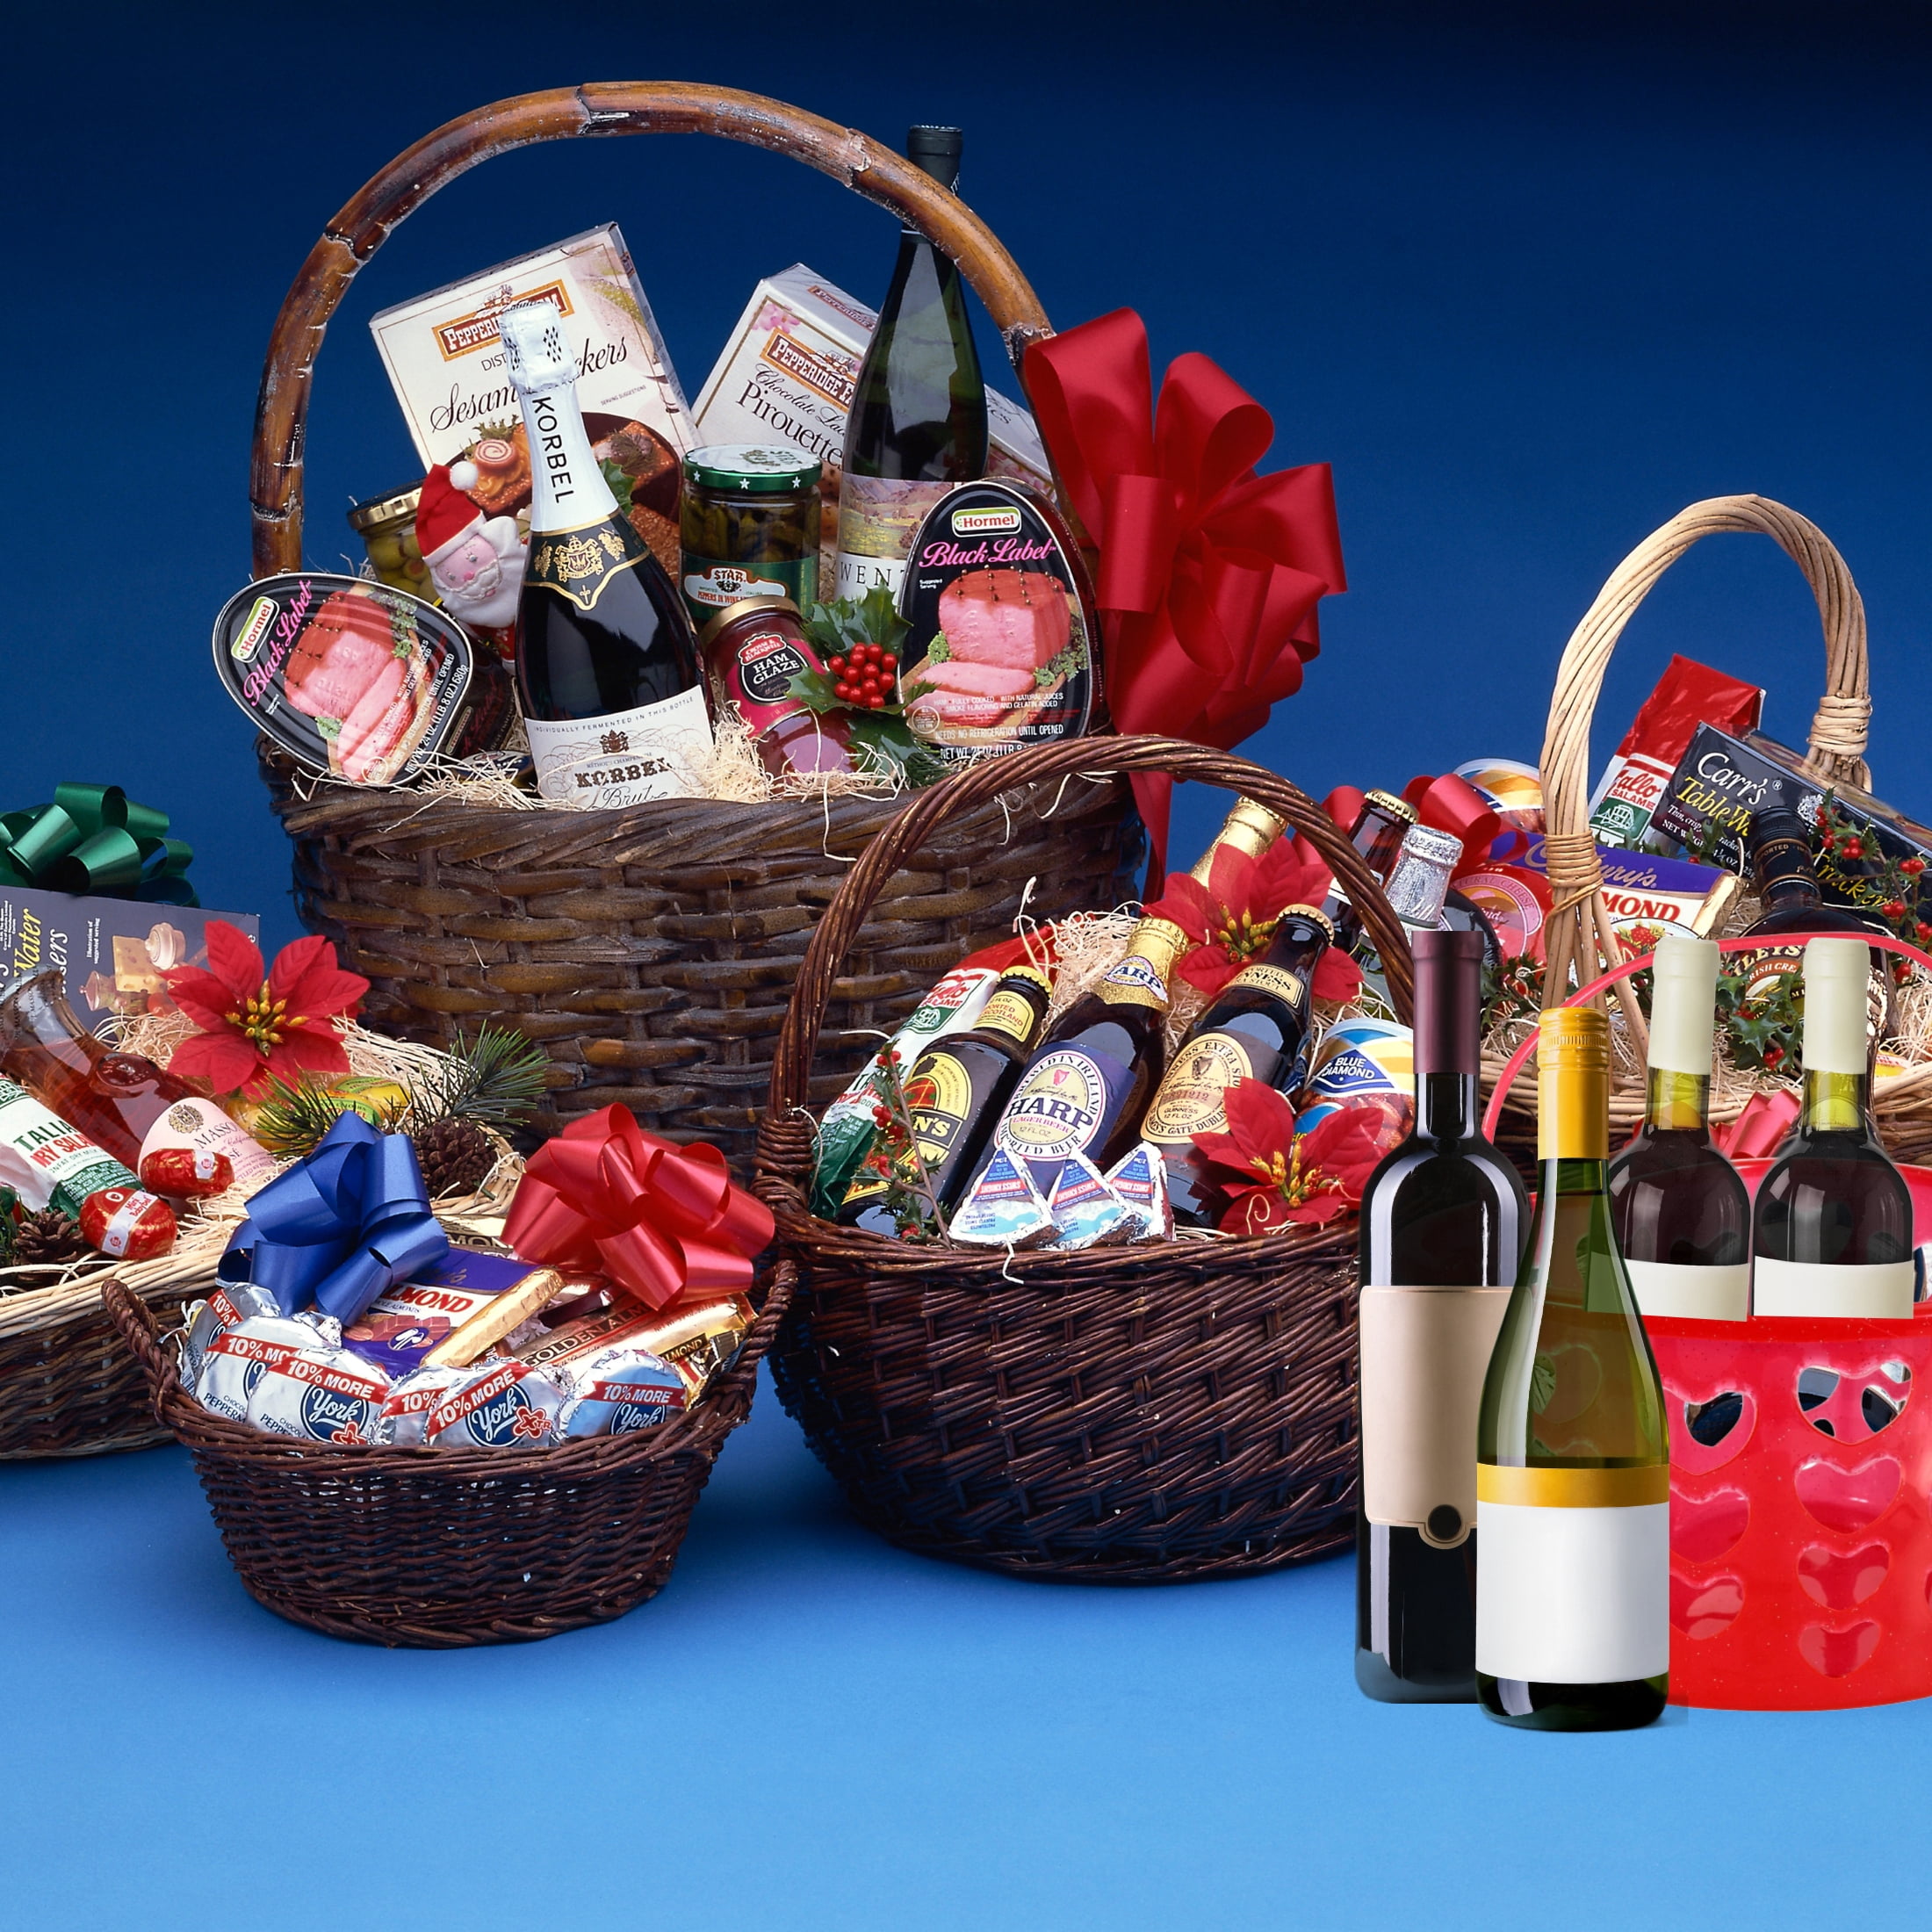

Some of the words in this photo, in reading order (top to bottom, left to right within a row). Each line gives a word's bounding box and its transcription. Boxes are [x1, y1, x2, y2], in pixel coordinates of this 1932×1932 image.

[481, 355, 508, 371] DIST
[772, 337, 843, 398] PEPPERIDGE
[754, 363, 816, 415] Chocolate
[430, 383, 519, 434] Sesam
[531, 396, 574, 504] KORBEL
[963, 514, 1015, 528] Hormel
[919, 541, 989, 568] Black
[840, 561, 905, 587] WEN
[240, 603, 271, 652] Hormel
[243, 639, 285, 707] Black
[428, 676, 444, 696] UNTIL
[437, 652, 457, 678] OPENED
[753, 652, 789, 674] HAM
[753, 660, 800, 685] GLAZE
[419, 734, 431, 746] 24
[451, 663, 470, 686] 680g
[582, 717, 633, 731] FERMENTED
[648, 706, 667, 717] THIS
[669, 696, 694, 711] BOTTLE
[1019, 724, 1037, 737] UNTIL
[1039, 724, 1063, 736] OPENED
[574, 756, 673, 789] KORBEL
[1698, 752, 1769, 806] Carr's
[598, 783, 662, 808] Brut
[1611, 789, 1656, 811] SALAME
[1676, 776, 1731, 820] Table
[1662, 818, 1680, 834] NET
[1669, 804, 1684, 821] Thin,
[1501, 879, 1535, 910] CHEESE
[1601, 890, 1681, 922] MOND
[1114, 966, 1161, 989] ARP
[1748, 962, 1772, 981] RISH
[1204, 1042, 1237, 1065] EXTRA
[1335, 1056, 1366, 1068] BLUE
[1014, 1056, 1056, 1099] BREWED
[1059, 1055, 1074, 1064] IN
[1076, 1060, 1099, 1115] IRELAND
[1321, 1062, 1375, 1080] DIAMOND
[912, 1115, 952, 1138] N'S
[1004, 1097, 1093, 1130] HARP
[1013, 1116, 1043, 1126] LAGER
[1043, 1119, 1070, 1134] BEER
[1167, 1124, 1195, 1135] GATE
[1196, 1109, 1227, 1131] DUBLIN
[194, 1121, 238, 1150] MASSO
[1000, 1122, 1043, 1155] IMPORTED
[1050, 1135, 1082, 1155] BEER
[229, 1147, 242, 1160] SÉ
[213, 1294, 230, 1322] 10%
[381, 1286, 474, 1314] LMOND
[526, 1325, 609, 1367] GOLDEN
[608, 1302, 652, 1329] ALM
[227, 1337, 263, 1359] 10%
[263, 1347, 291, 1363] MO
[287, 1359, 322, 1384] 10%
[324, 1373, 376, 1399] MORE
[308, 1388, 362, 1424] York
[401, 1390, 436, 1412] 10%
[436, 1396, 472, 1428] 10%
[472, 1369, 516, 1407] MORE
[603, 1384, 632, 1402] 10%
[634, 1388, 674, 1403] MORE
[471, 1387, 518, 1442] York
[620, 1402, 660, 1435] York
